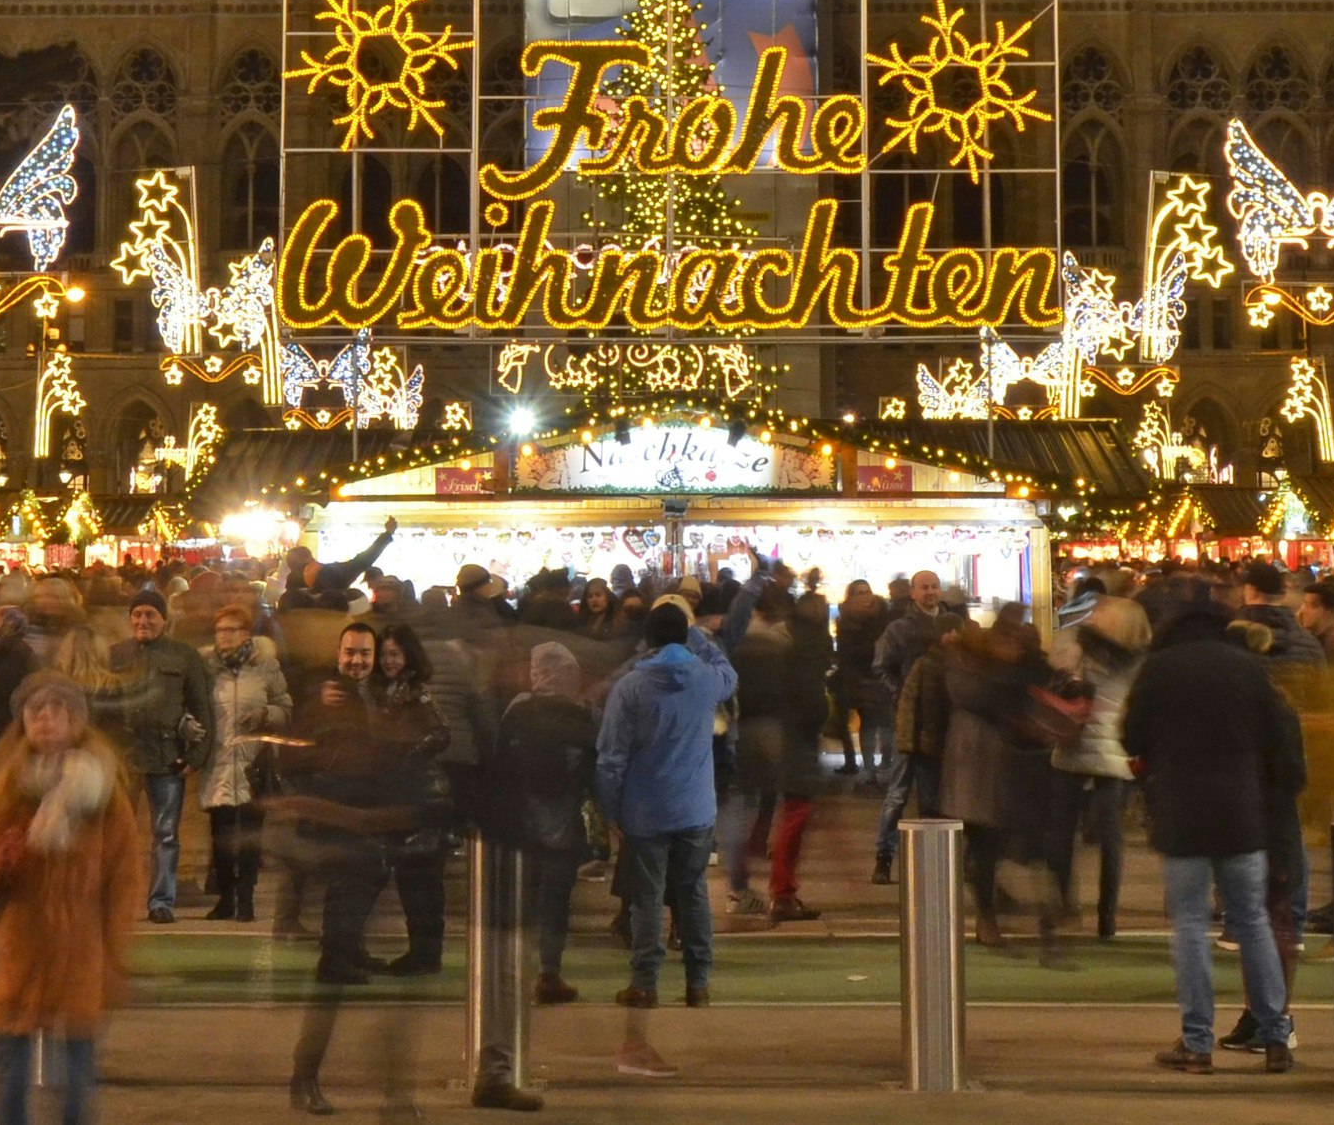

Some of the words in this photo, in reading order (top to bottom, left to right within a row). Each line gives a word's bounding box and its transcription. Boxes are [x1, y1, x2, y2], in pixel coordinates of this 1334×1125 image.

[478, 39, 866, 200] Frohe
[278, 198, 1062, 330] Weihnachten
[579, 431, 769, 473] Nachkaze
